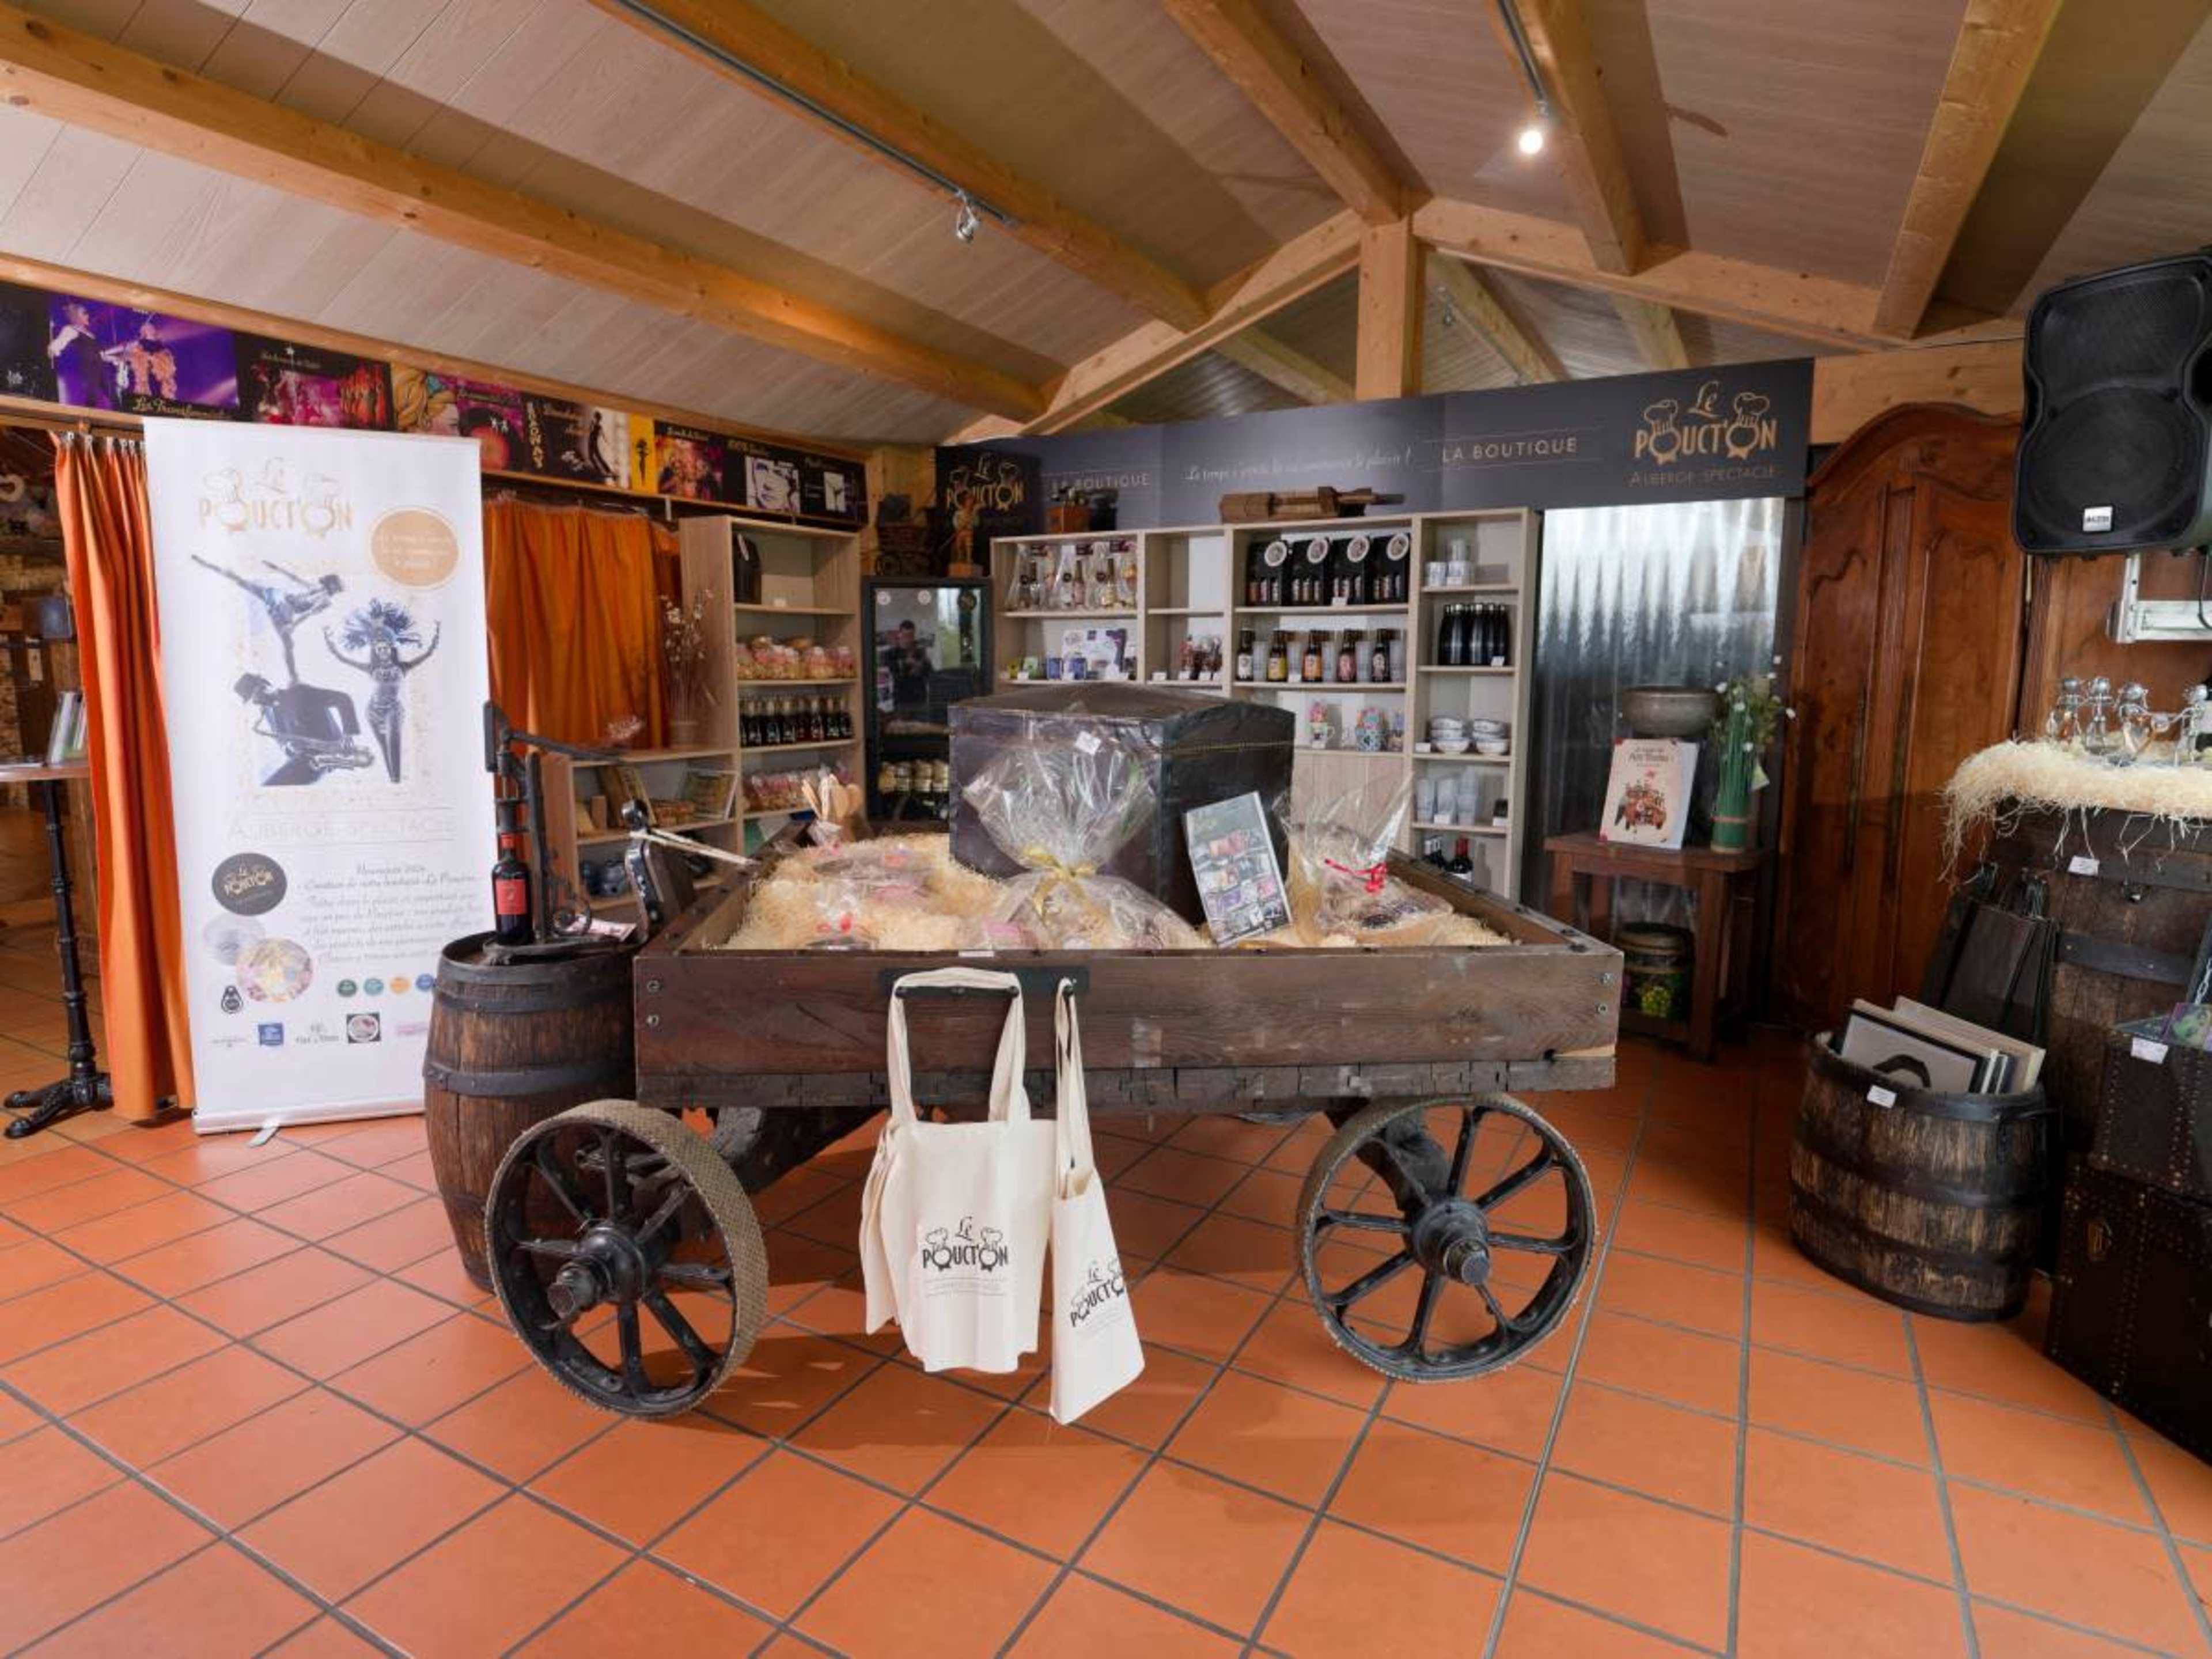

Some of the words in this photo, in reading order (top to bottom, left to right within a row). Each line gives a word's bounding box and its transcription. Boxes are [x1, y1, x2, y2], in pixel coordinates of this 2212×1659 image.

[1688, 381, 1722, 419] Le
[1443, 446, 1464, 462] LA
[1473, 437, 1578, 459] BOUTIQUE
[954, 1215, 974, 1241] Le
